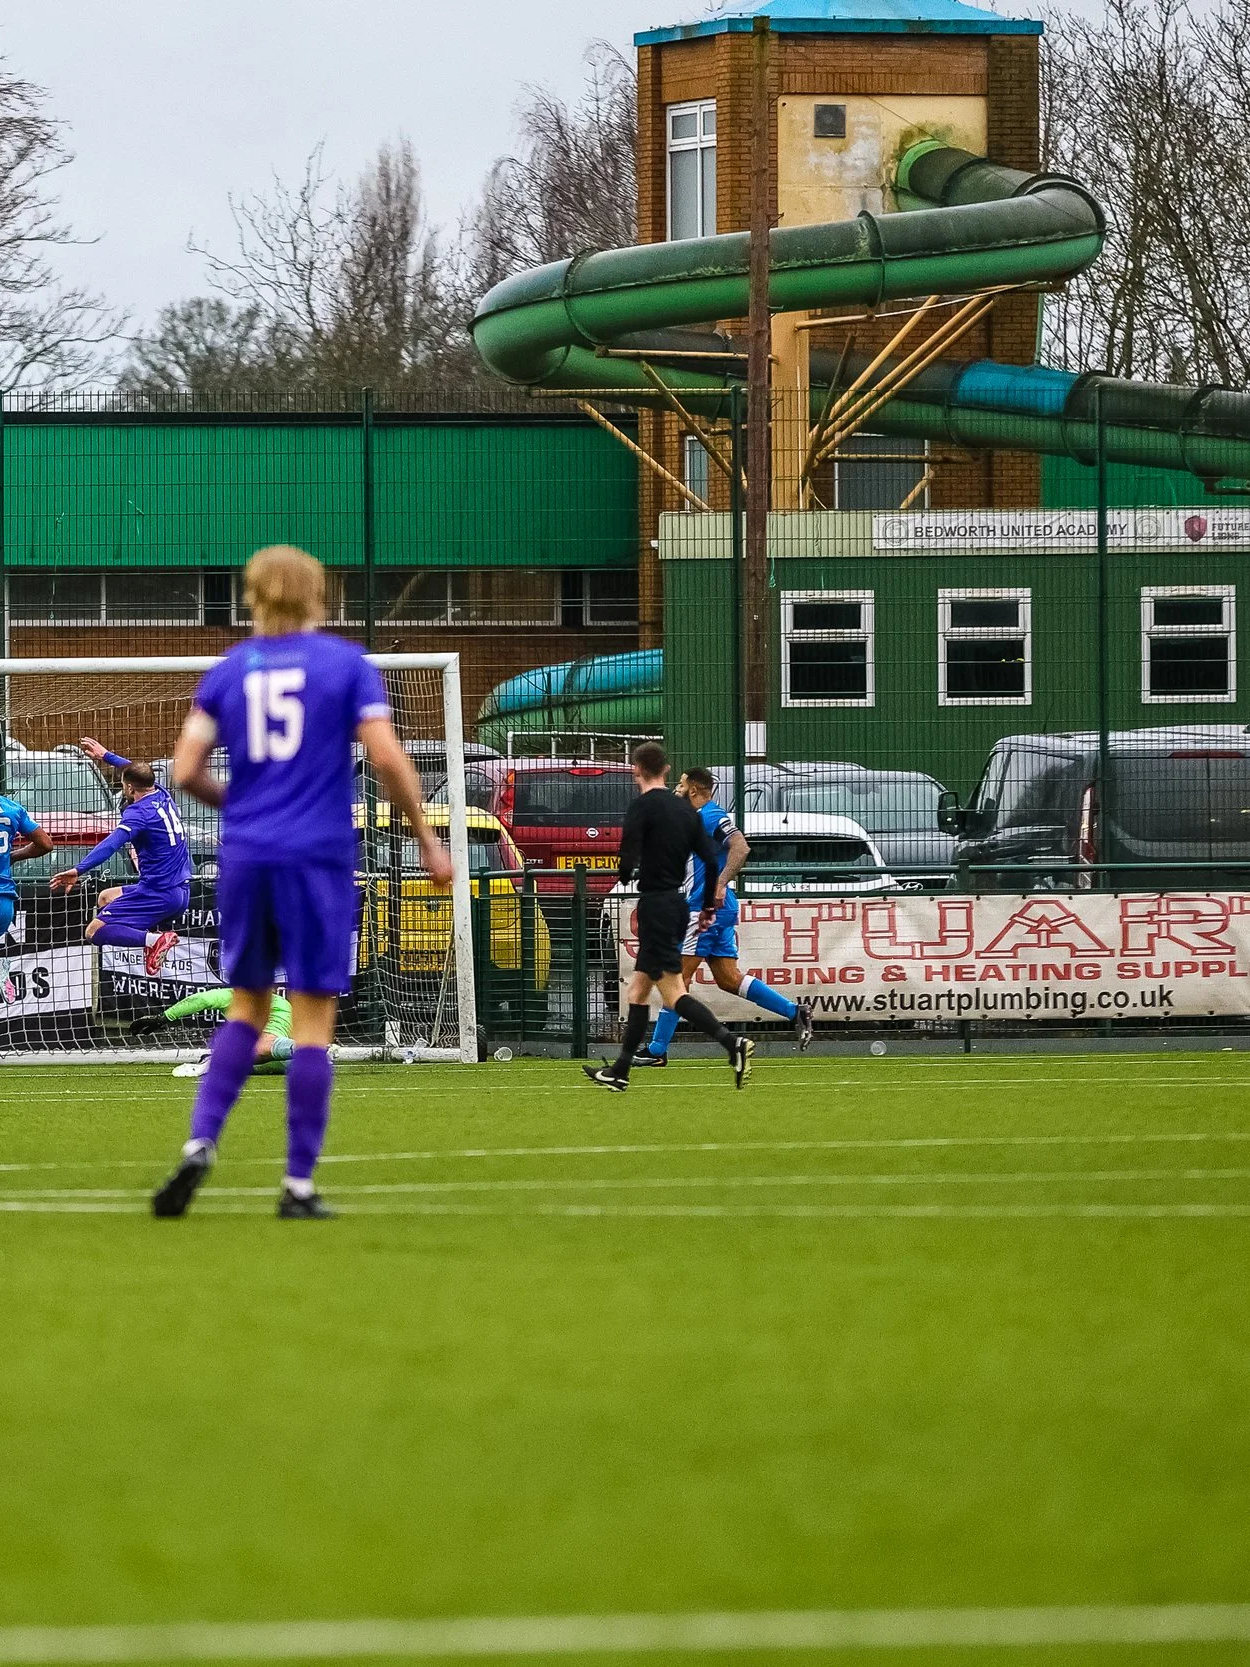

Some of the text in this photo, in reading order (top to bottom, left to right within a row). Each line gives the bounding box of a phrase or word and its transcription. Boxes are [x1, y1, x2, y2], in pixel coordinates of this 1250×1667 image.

[914, 523, 1128, 538] BEDWORTH UNITED ACADMY
[244, 667, 306, 763] 15
[157, 802, 185, 846] 14
[623, 896, 1250, 962] TUAR
[114, 952, 193, 971] GINGEEADS
[690, 966, 864, 985] UBING
[881, 965, 908, 981] &
[925, 963, 1102, 982] HEATING
[797, 985, 1174, 1017] www.stuartplumbing.co.uk
